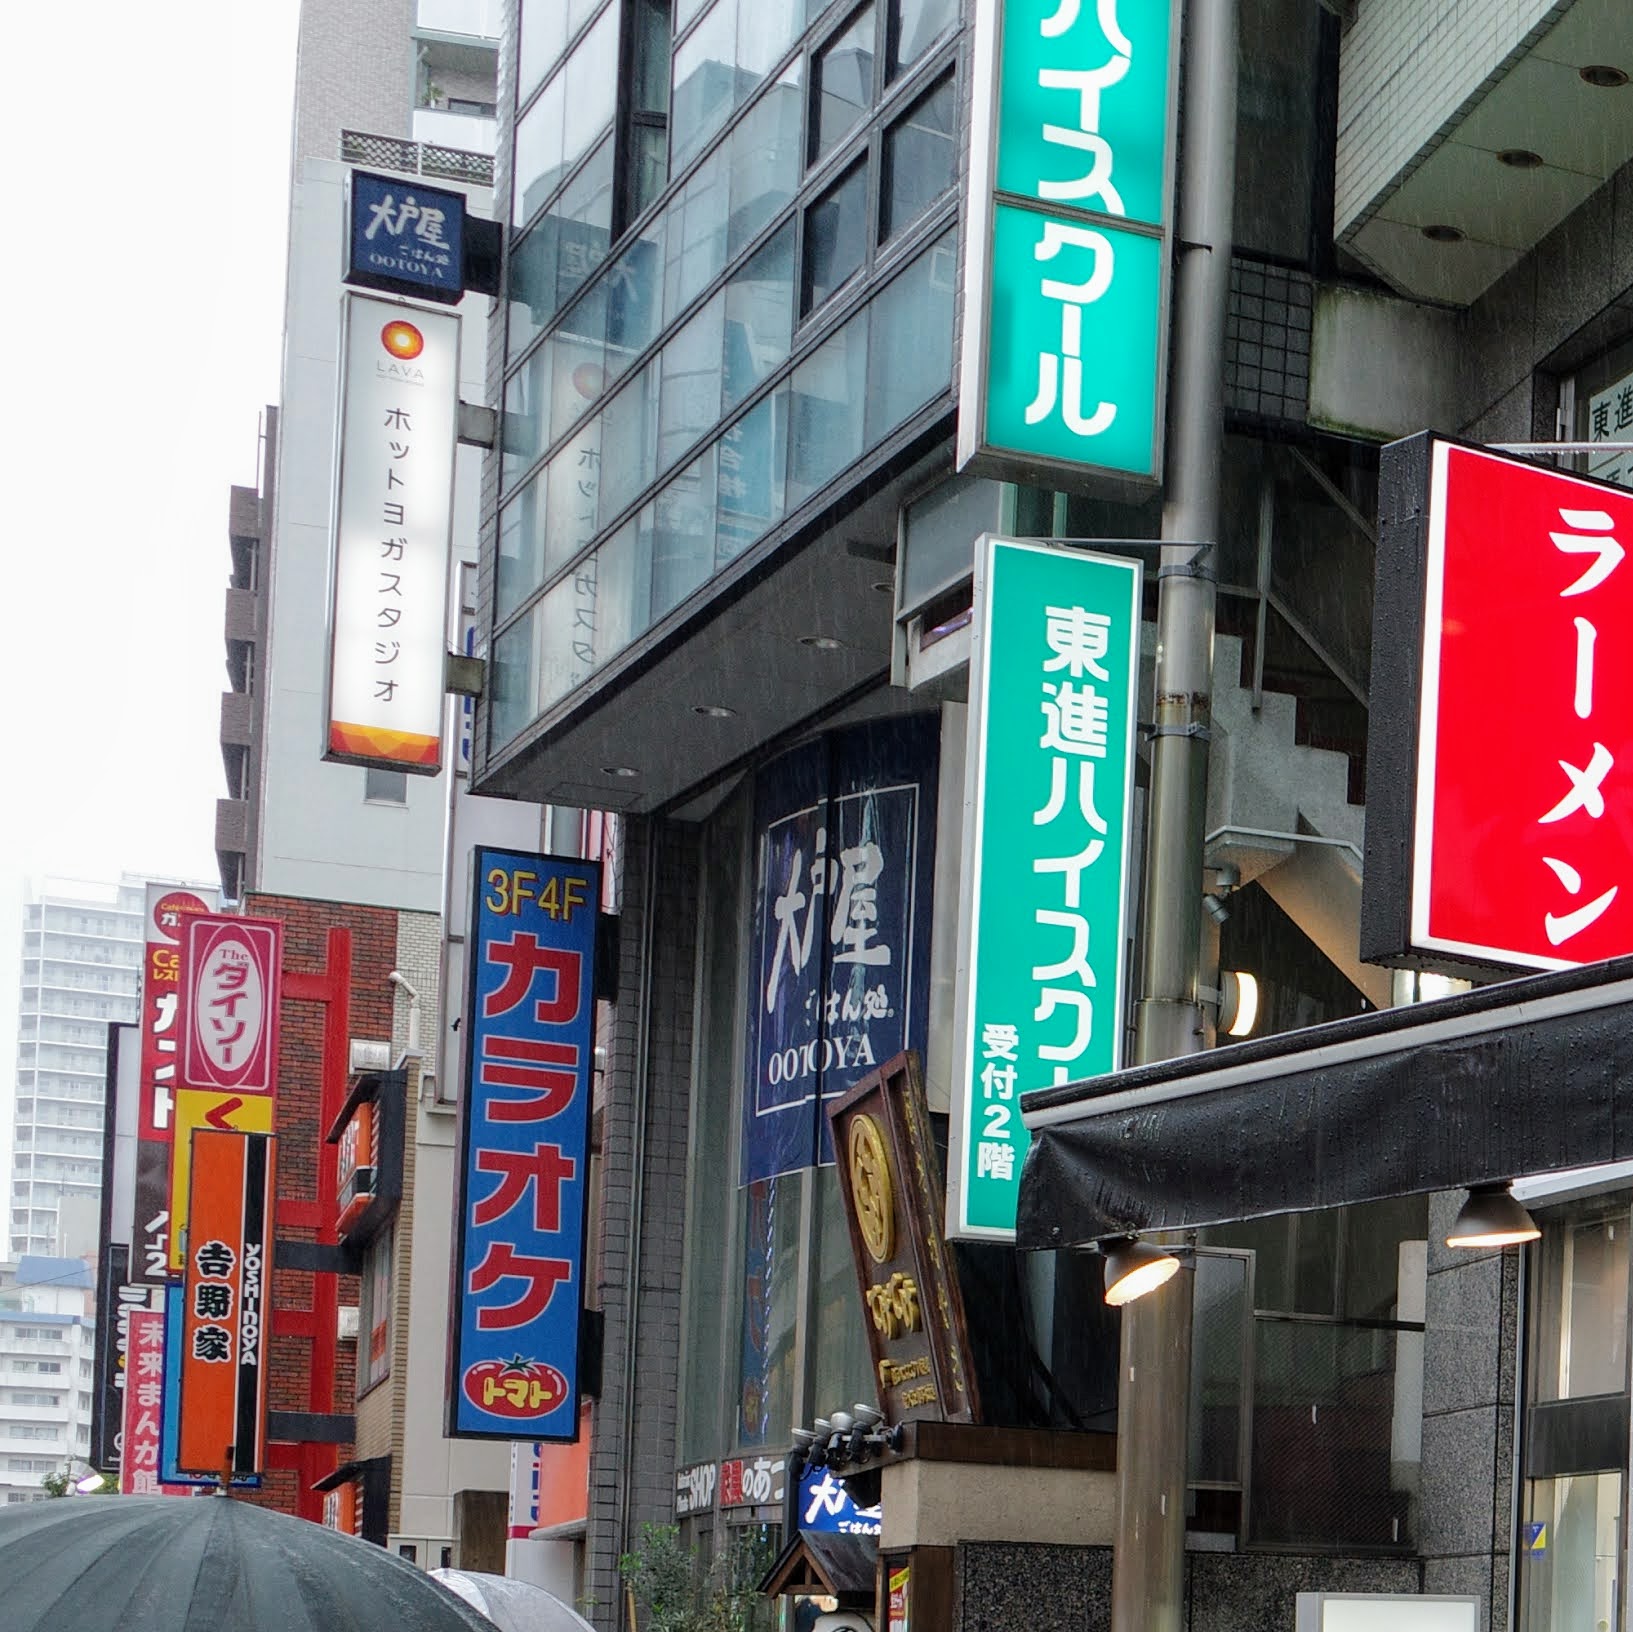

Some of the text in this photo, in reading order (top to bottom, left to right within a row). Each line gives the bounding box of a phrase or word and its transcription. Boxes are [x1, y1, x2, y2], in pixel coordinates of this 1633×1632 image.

[365, 194, 450, 250] 大戸屋
[369, 252, 444, 279] OOTOYA
[376, 360, 425, 379] LAVA
[372, 406, 412, 704] ホットヨガスタジオ
[1536, 507, 1626, 947] ラーメン
[220, 948, 249, 961] The
[208, 962, 250, 1065] ダイソー
[470, 931, 582, 1332] カラオケ
[976, 1022, 1019, 1182] 受付2階
[193, 1240, 237, 1363] 吉野家
[482, 1377, 553, 1409] トマト
